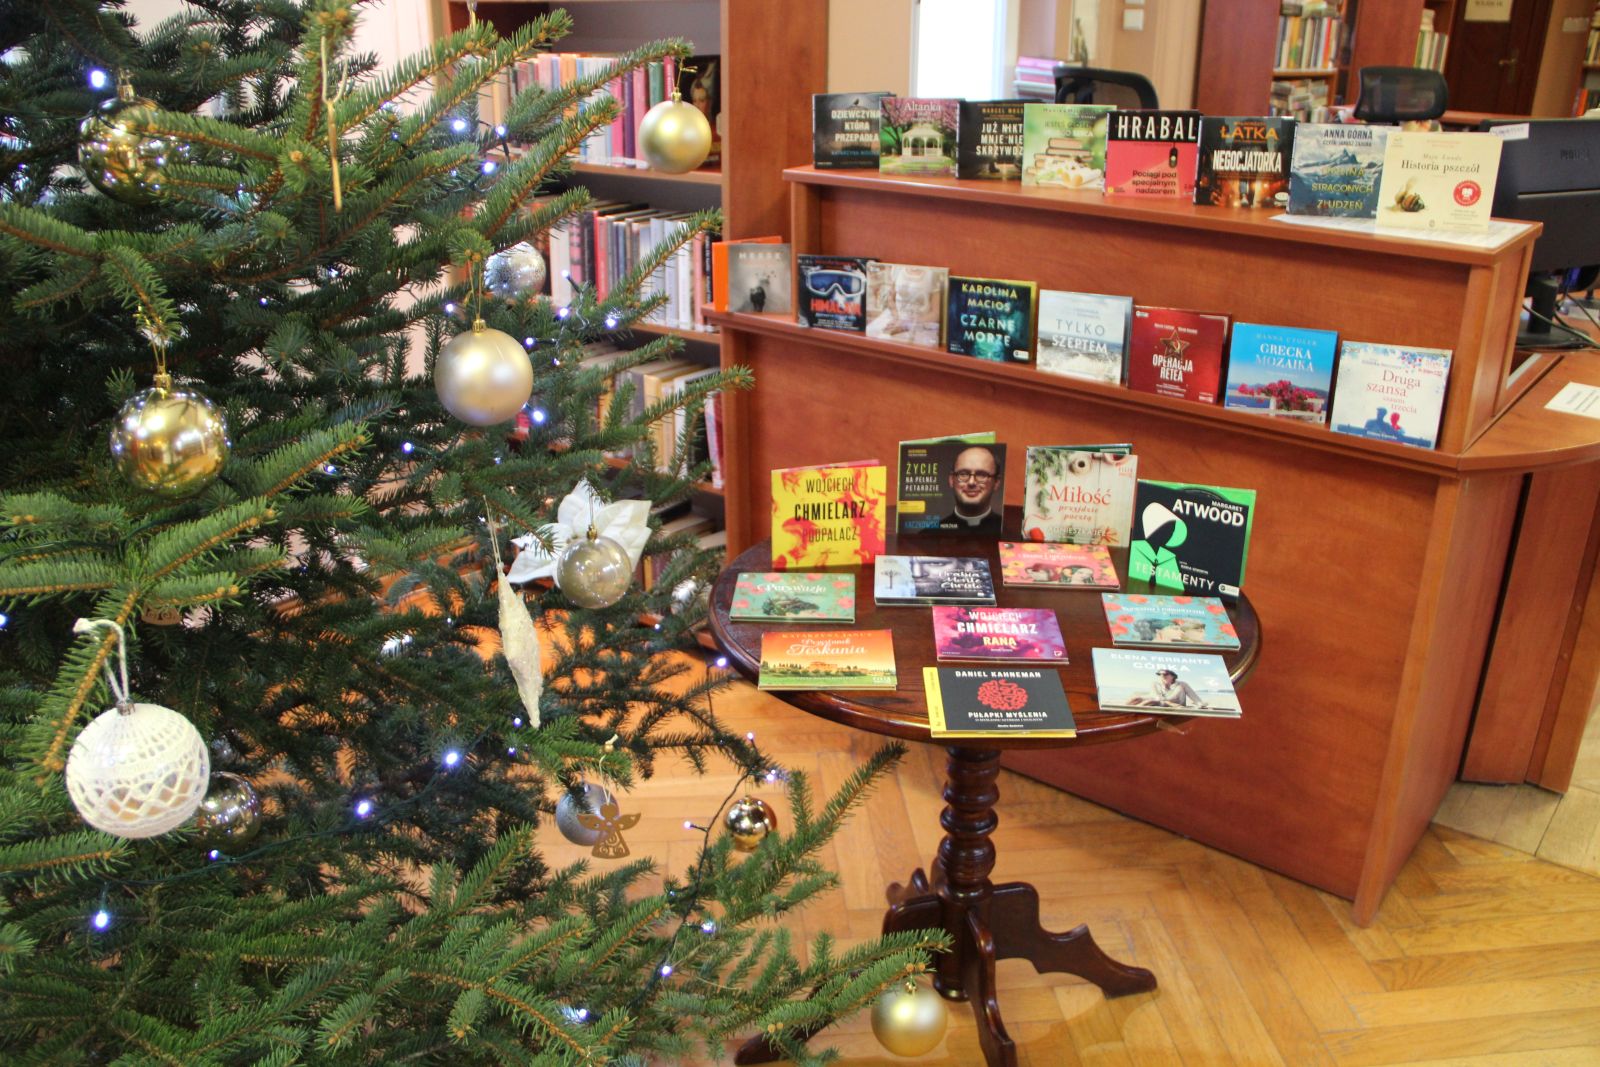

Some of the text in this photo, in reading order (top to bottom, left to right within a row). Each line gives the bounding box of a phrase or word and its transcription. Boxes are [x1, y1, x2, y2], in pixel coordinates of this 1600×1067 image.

[904, 101, 941, 111] Altanka
[844, 120, 870, 131] KTÓRA
[982, 121, 1024, 133] JUŻ NIKT
[1117, 116, 1197, 140] HRABAL
[1220, 126, 1279, 140] ŁATKA
[835, 133, 879, 142] PRZEPADŁA
[981, 134, 1023, 145] MNIE NIE
[1324, 129, 1373, 140] ANNA GÓRNA
[1213, 150, 1281, 172] NEGOCJATORKA
[1401, 159, 1480, 174] Historia pszczół
[1132, 179, 1177, 187] specjalnym
[1311, 183, 1373, 193] STRACONYCH
[962, 283, 1018, 299] KAROLINA
[967, 299, 1010, 312] MACIOS
[960, 314, 1016, 331] CZARNE
[1056, 319, 1105, 337] TYLKO
[963, 331, 1011, 347] MORZE
[1052, 334, 1108, 354] SZEPTEM
[1260, 343, 1312, 360] GRECKA
[1152, 354, 1193, 372] OPERACJA
[1255, 354, 1313, 372] MOZAIKA
[1160, 367, 1183, 382] RETEA
[1383, 369, 1420, 389] Druga
[1367, 383, 1406, 397] szansa
[906, 461, 938, 475] ŻYCIE
[806, 476, 854, 493] WOJCIECH
[905, 484, 939, 492] PETARDZIE
[1047, 484, 1112, 505] Miłość
[794, 500, 866, 521] CHMIELARZ
[1172, 499, 1244, 527] ATWOOD
[1211, 501, 1243, 512] MARGARET
[802, 527, 857, 543] PODPALACZ
[1136, 560, 1214, 591] TESTAMENTY
[968, 611, 1022, 622] WOJCIECH
[956, 621, 1038, 634] CHMIELARZ
[786, 643, 866, 656] Toskania
[968, 711, 1003, 719] PUŁAPKI
